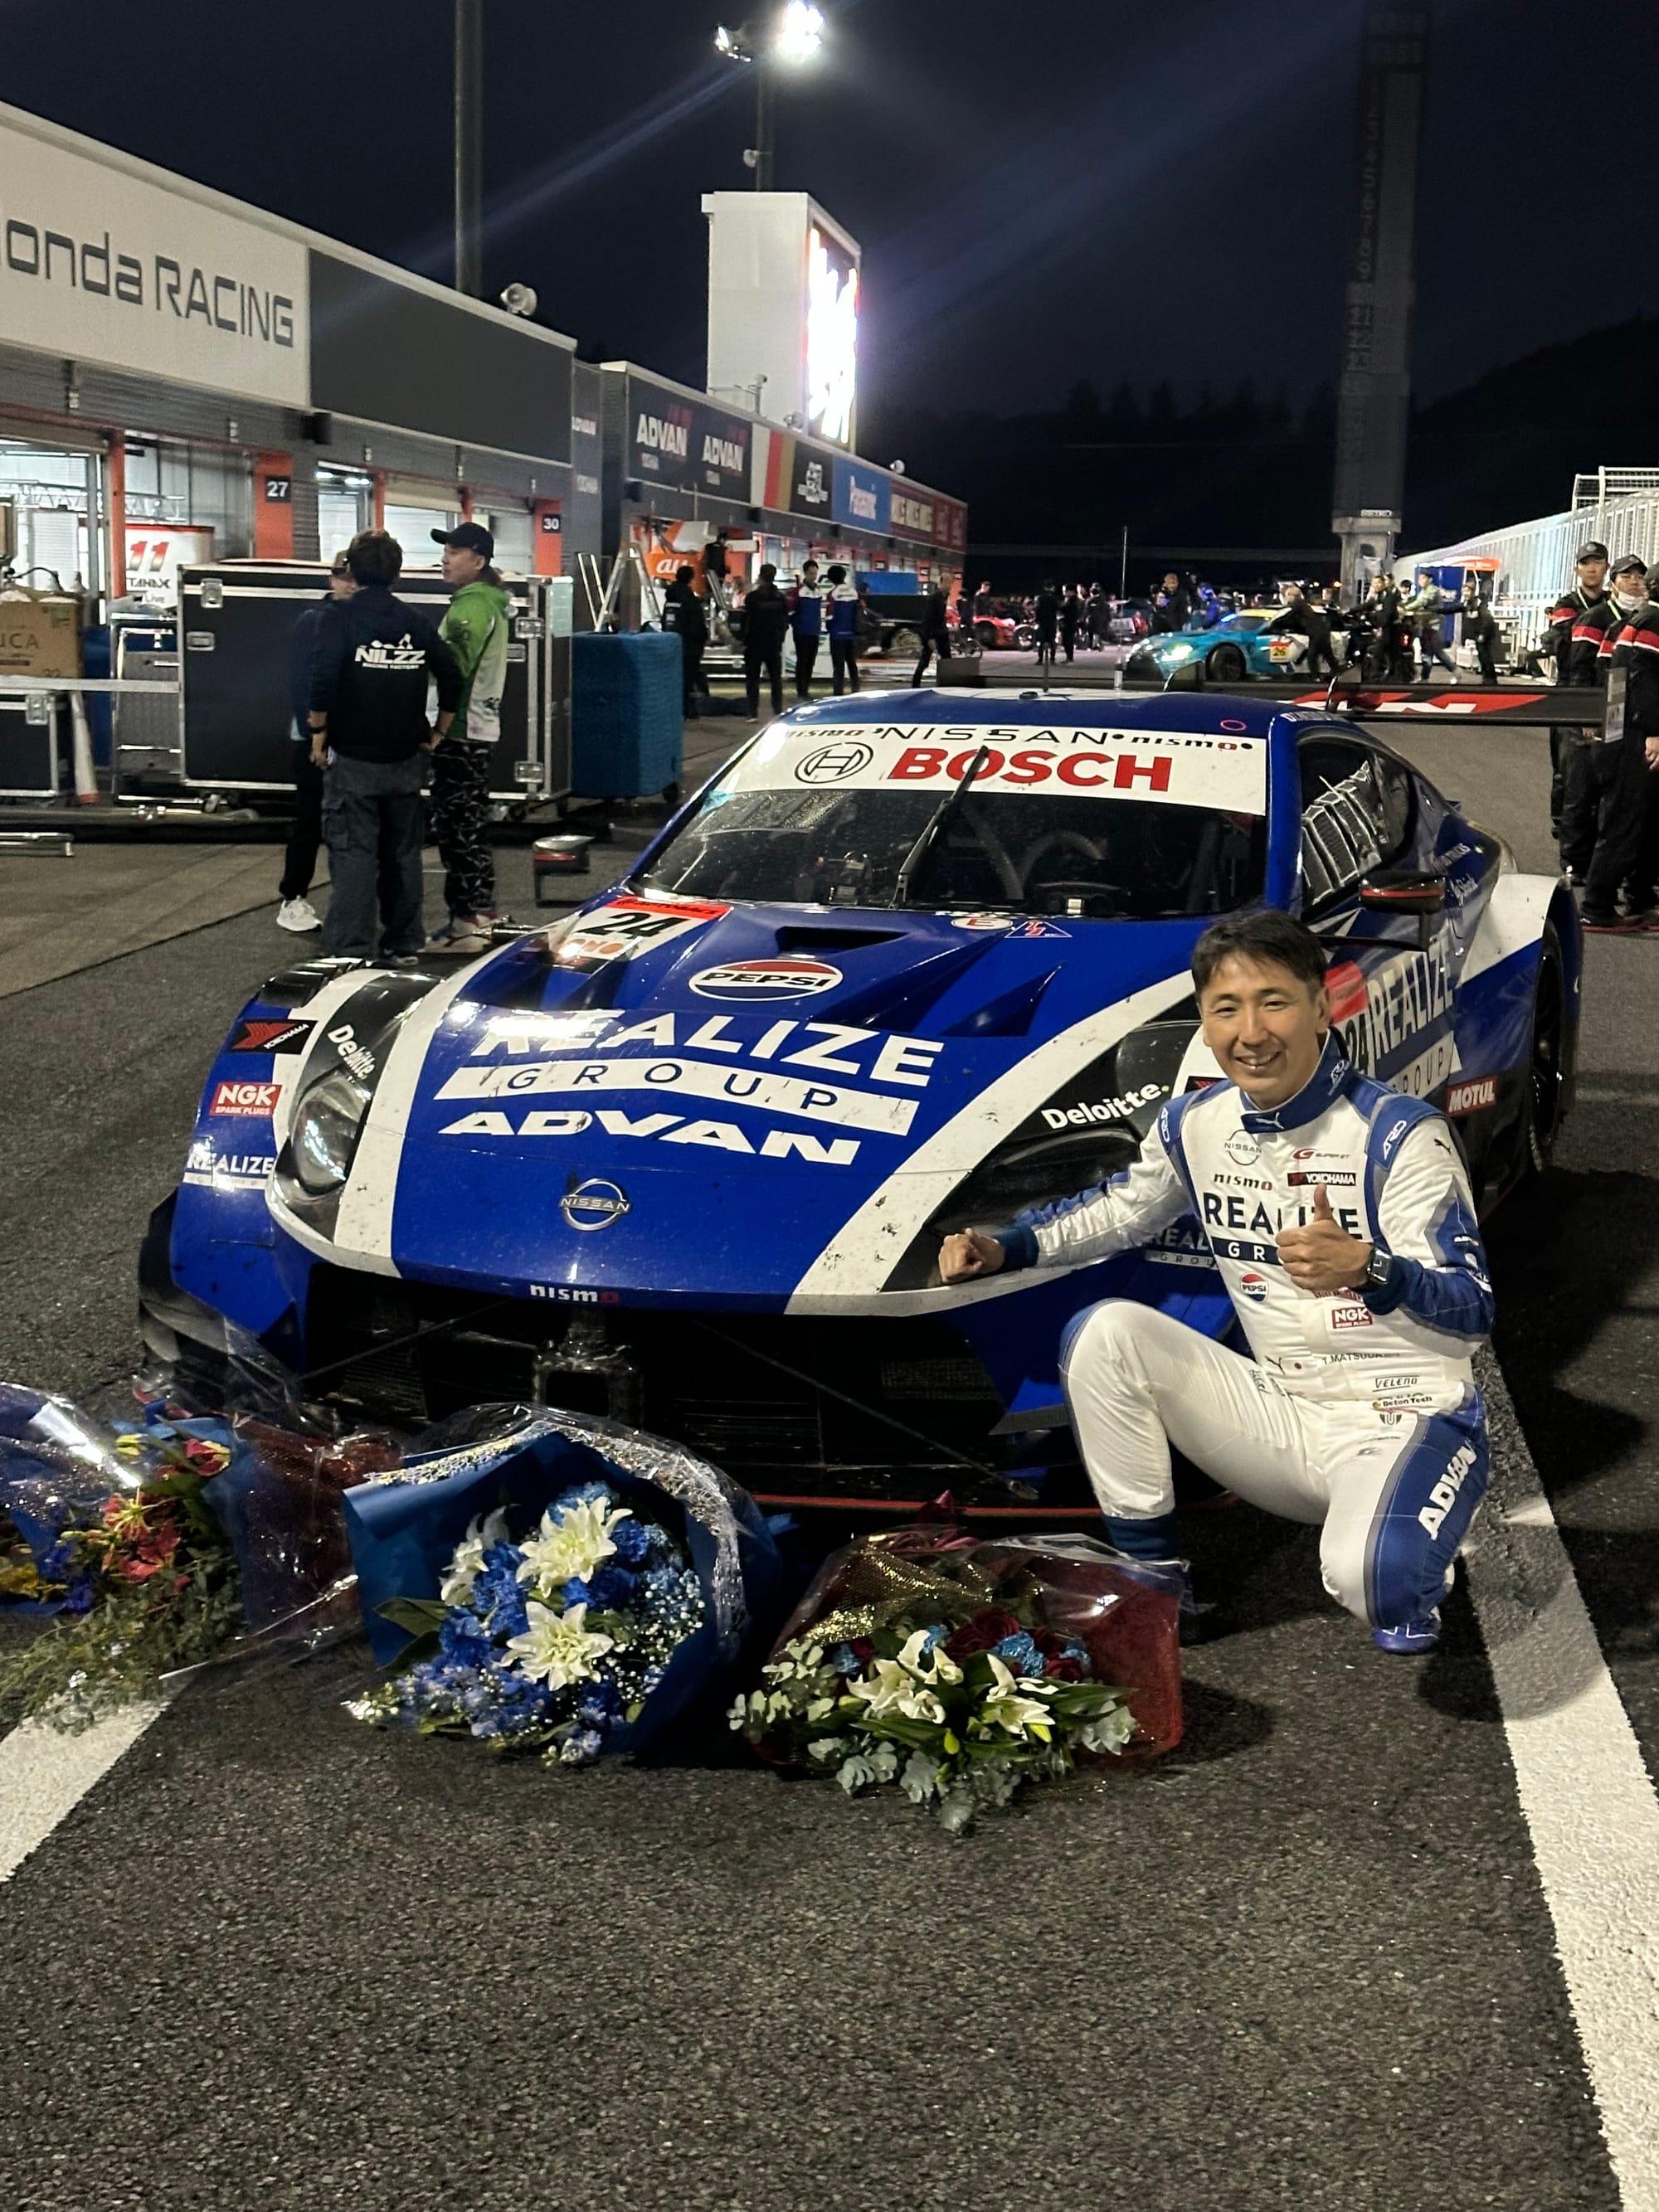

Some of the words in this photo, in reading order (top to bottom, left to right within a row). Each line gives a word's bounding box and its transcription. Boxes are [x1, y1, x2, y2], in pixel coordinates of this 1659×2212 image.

[0, 219, 142, 305] onda
[155, 255, 293, 348] RACING
[637, 414, 688, 457] ADVAN
[703, 435, 744, 471] ADVAN
[267, 481, 289, 497] 27
[543, 518, 559, 530] 30
[128, 541, 169, 571] 11
[880, 727, 1108, 744] NISSAN
[1131, 735, 1238, 751] nismo
[887, 748, 1172, 792] BOSCH
[575, 912, 692, 940] 24
[702, 973, 831, 987] PEPSI
[1367, 935, 1453, 1060] REALIZE
[263, 1023, 309, 1050] YOKOHAMA
[470, 1009, 945, 1087] REALIZE
[217, 1085, 277, 1106] NGK
[507, 1063, 838, 1110] GROUP
[1448, 1082, 1494, 1111] MOTUL
[438, 1110, 861, 1164] ADVAN
[1224, 1142, 1262, 1154] NISSAN
[187, 1151, 275, 1174] REALIZE
[1213, 1174, 1272, 1191] nismo
[1306, 1173, 1355, 1185] YOKOHAMA
[560, 1198, 630, 1212] NISSAN
[530, 1285, 619, 1304] nismo
[1243, 1284, 1267, 1292] PEPSI
[1335, 1307, 1369, 1322] NGK
[1383, 1398, 1408, 1407] Beton
